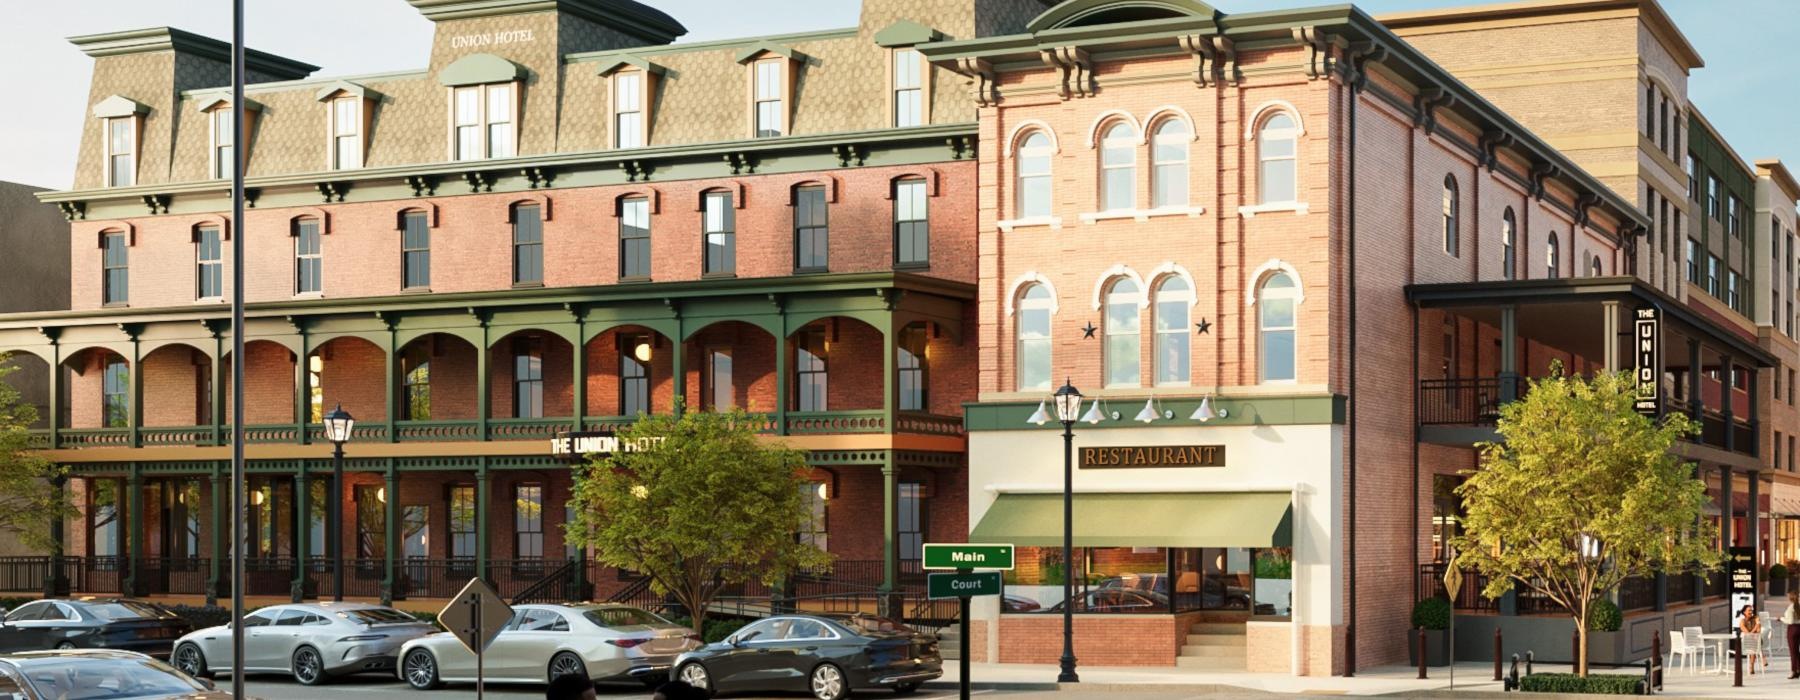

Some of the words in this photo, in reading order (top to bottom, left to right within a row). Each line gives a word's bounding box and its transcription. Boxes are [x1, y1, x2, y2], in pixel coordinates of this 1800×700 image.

[452, 33, 490, 48] UNION
[495, 29, 534, 44] HOTEL
[1637, 309, 1654, 318] THE
[1642, 325, 1651, 394] UNION
[551, 438, 571, 454] THE
[574, 437, 618, 453] UNION
[1085, 447, 1216, 465] RESTAURANT
[951, 552, 985, 562] Main
[951, 580, 982, 589] Court
